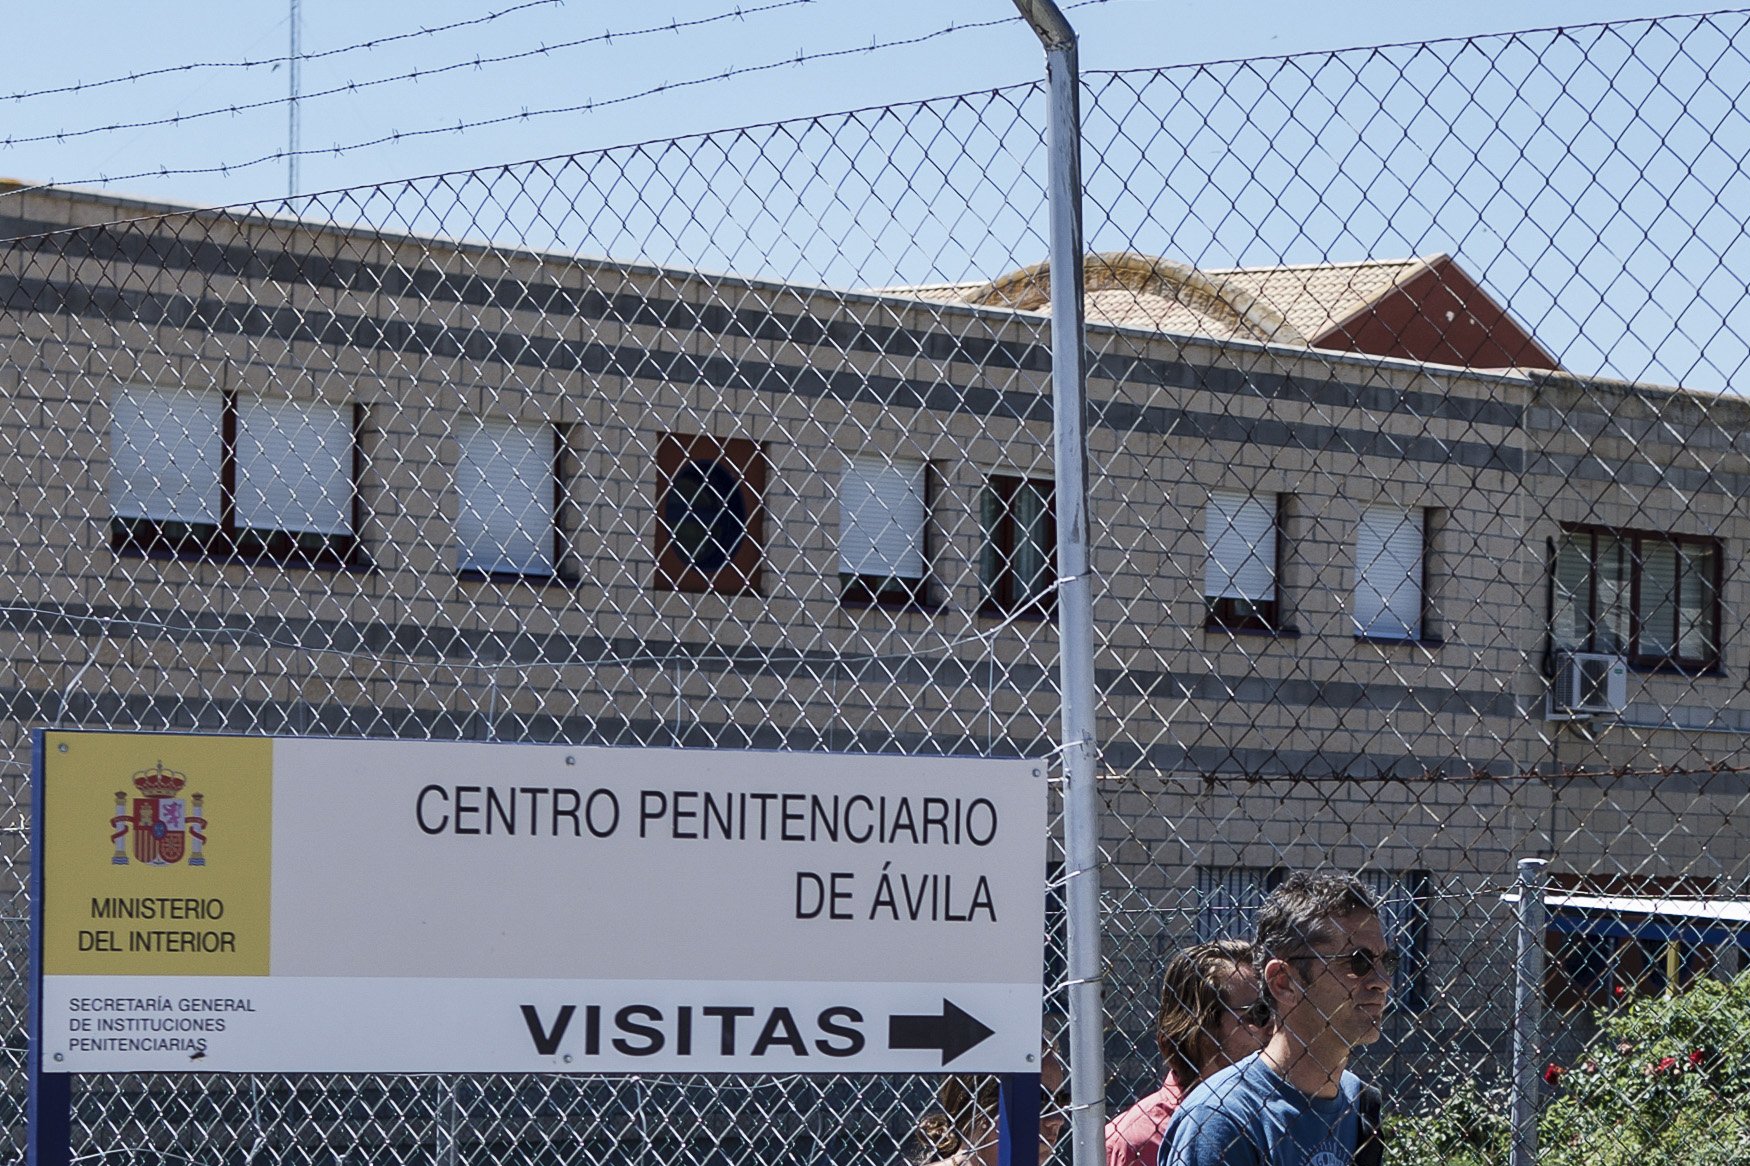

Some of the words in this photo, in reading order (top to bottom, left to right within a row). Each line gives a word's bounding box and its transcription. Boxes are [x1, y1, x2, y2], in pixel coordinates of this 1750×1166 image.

[415, 784, 620, 839] CENTRO
[639, 789, 998, 847] PENITENCIARIO
[795, 871, 855, 921] DE
[868, 859, 998, 923] ÁVILA
[91, 897, 224, 920] MINISTERIO
[78, 930, 123, 952] DEL
[129, 930, 236, 953] INTERIOR
[68, 995, 174, 1012] SECRETARÍA
[177, 998, 257, 1013] GENERAL
[69, 1017, 93, 1032] DE
[96, 1017, 227, 1032] INSTITUCIONES
[519, 1003, 866, 1058] VISITAS
[68, 1037, 208, 1052] PENITENCIARIAS
